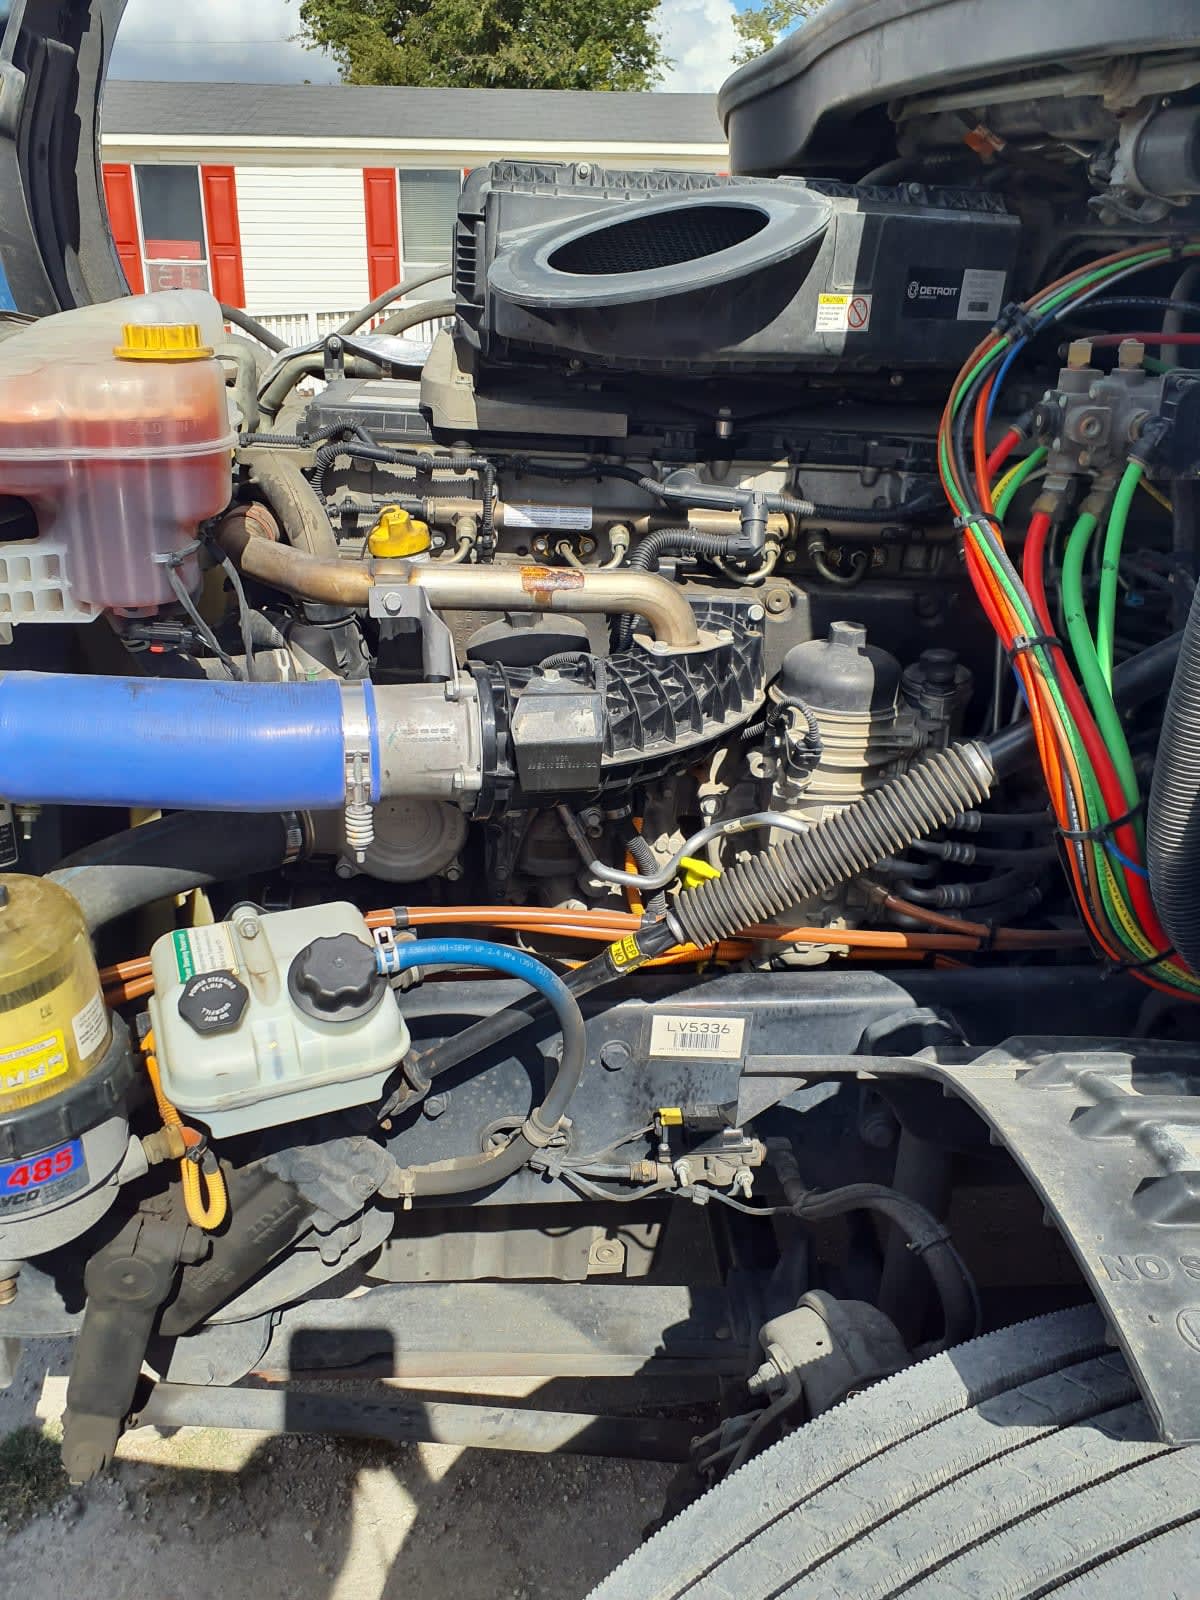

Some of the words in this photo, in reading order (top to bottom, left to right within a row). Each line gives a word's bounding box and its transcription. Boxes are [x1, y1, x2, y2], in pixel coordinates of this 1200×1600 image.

[920, 286, 958, 296] DETROIT
[666, 1022, 731, 1034] LV5336
[7, 1146, 74, 1188] 485
[1097, 1254, 1170, 1281] NO
